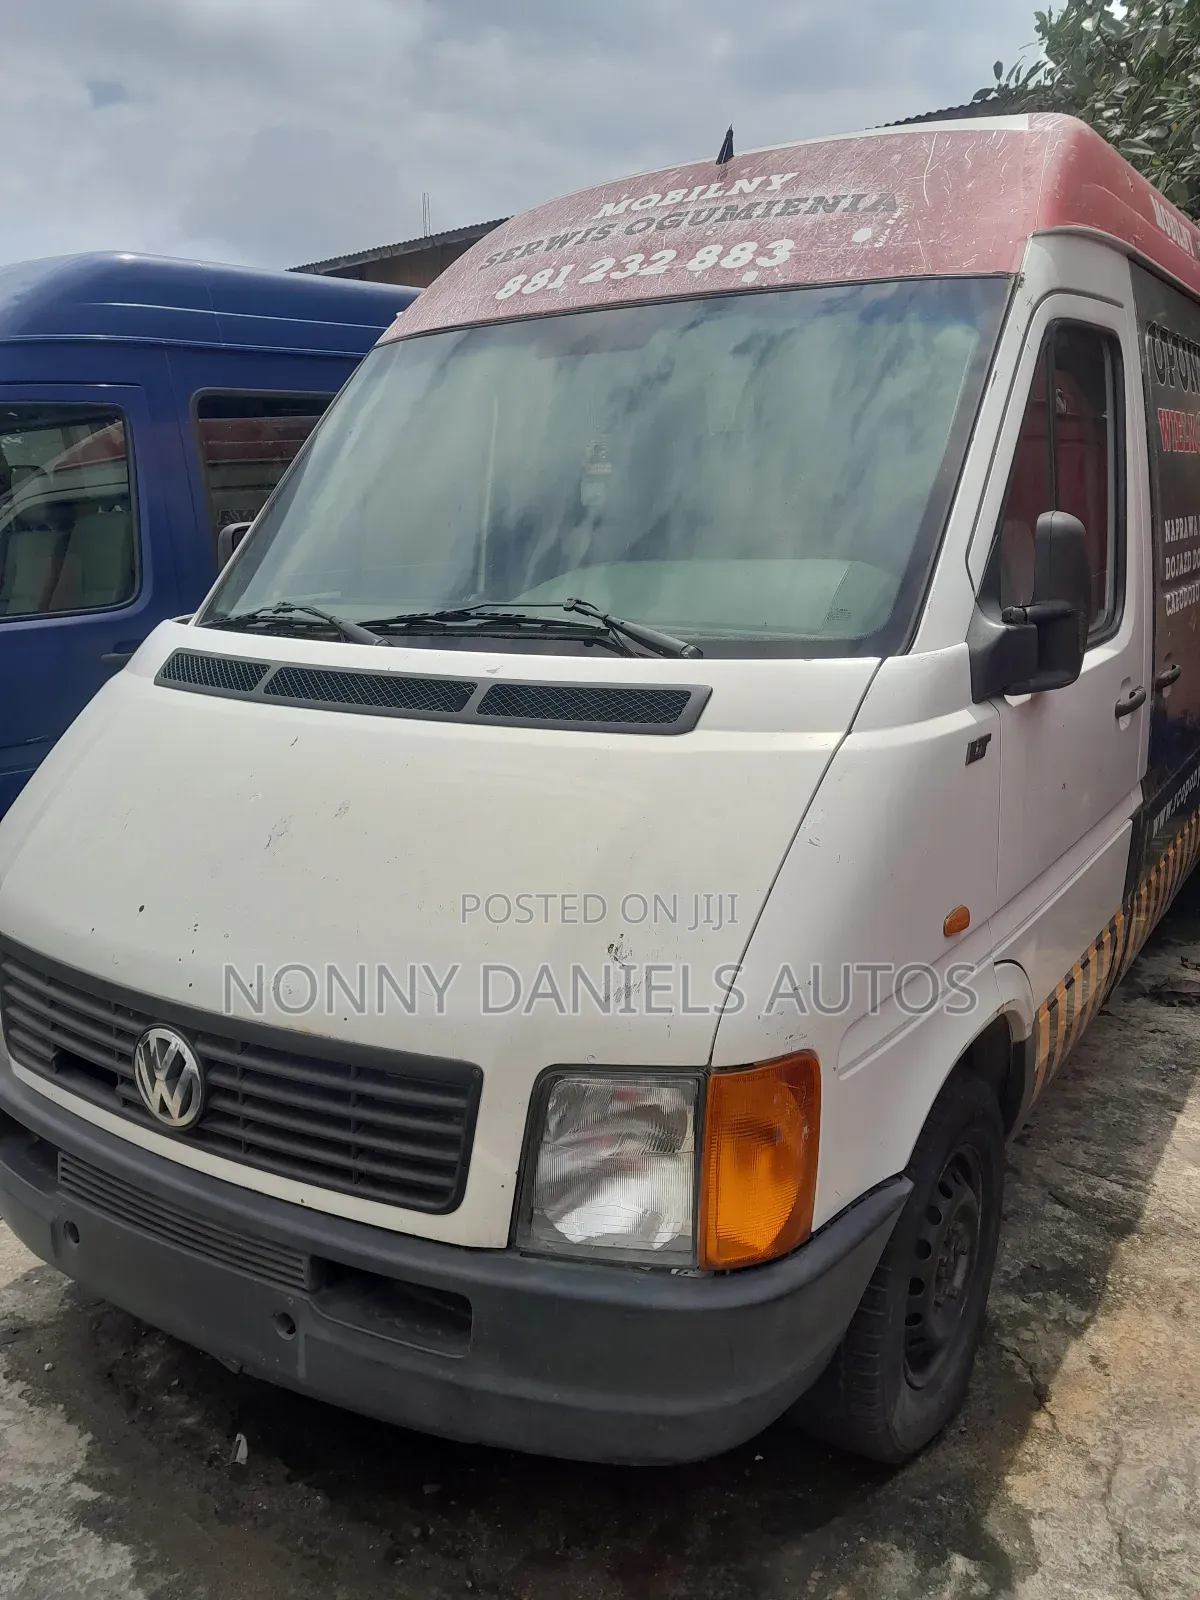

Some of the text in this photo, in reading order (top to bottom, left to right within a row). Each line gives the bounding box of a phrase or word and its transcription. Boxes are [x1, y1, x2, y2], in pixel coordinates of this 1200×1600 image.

[593, 171, 800, 219] MOBILNY
[479, 192, 897, 270] SERWIS OGUMIENIA
[495, 239, 795, 300] 881 232 883
[1164, 515, 1198, 543] NAPRAWA
[1165, 550, 1192, 580] DOJAZD
